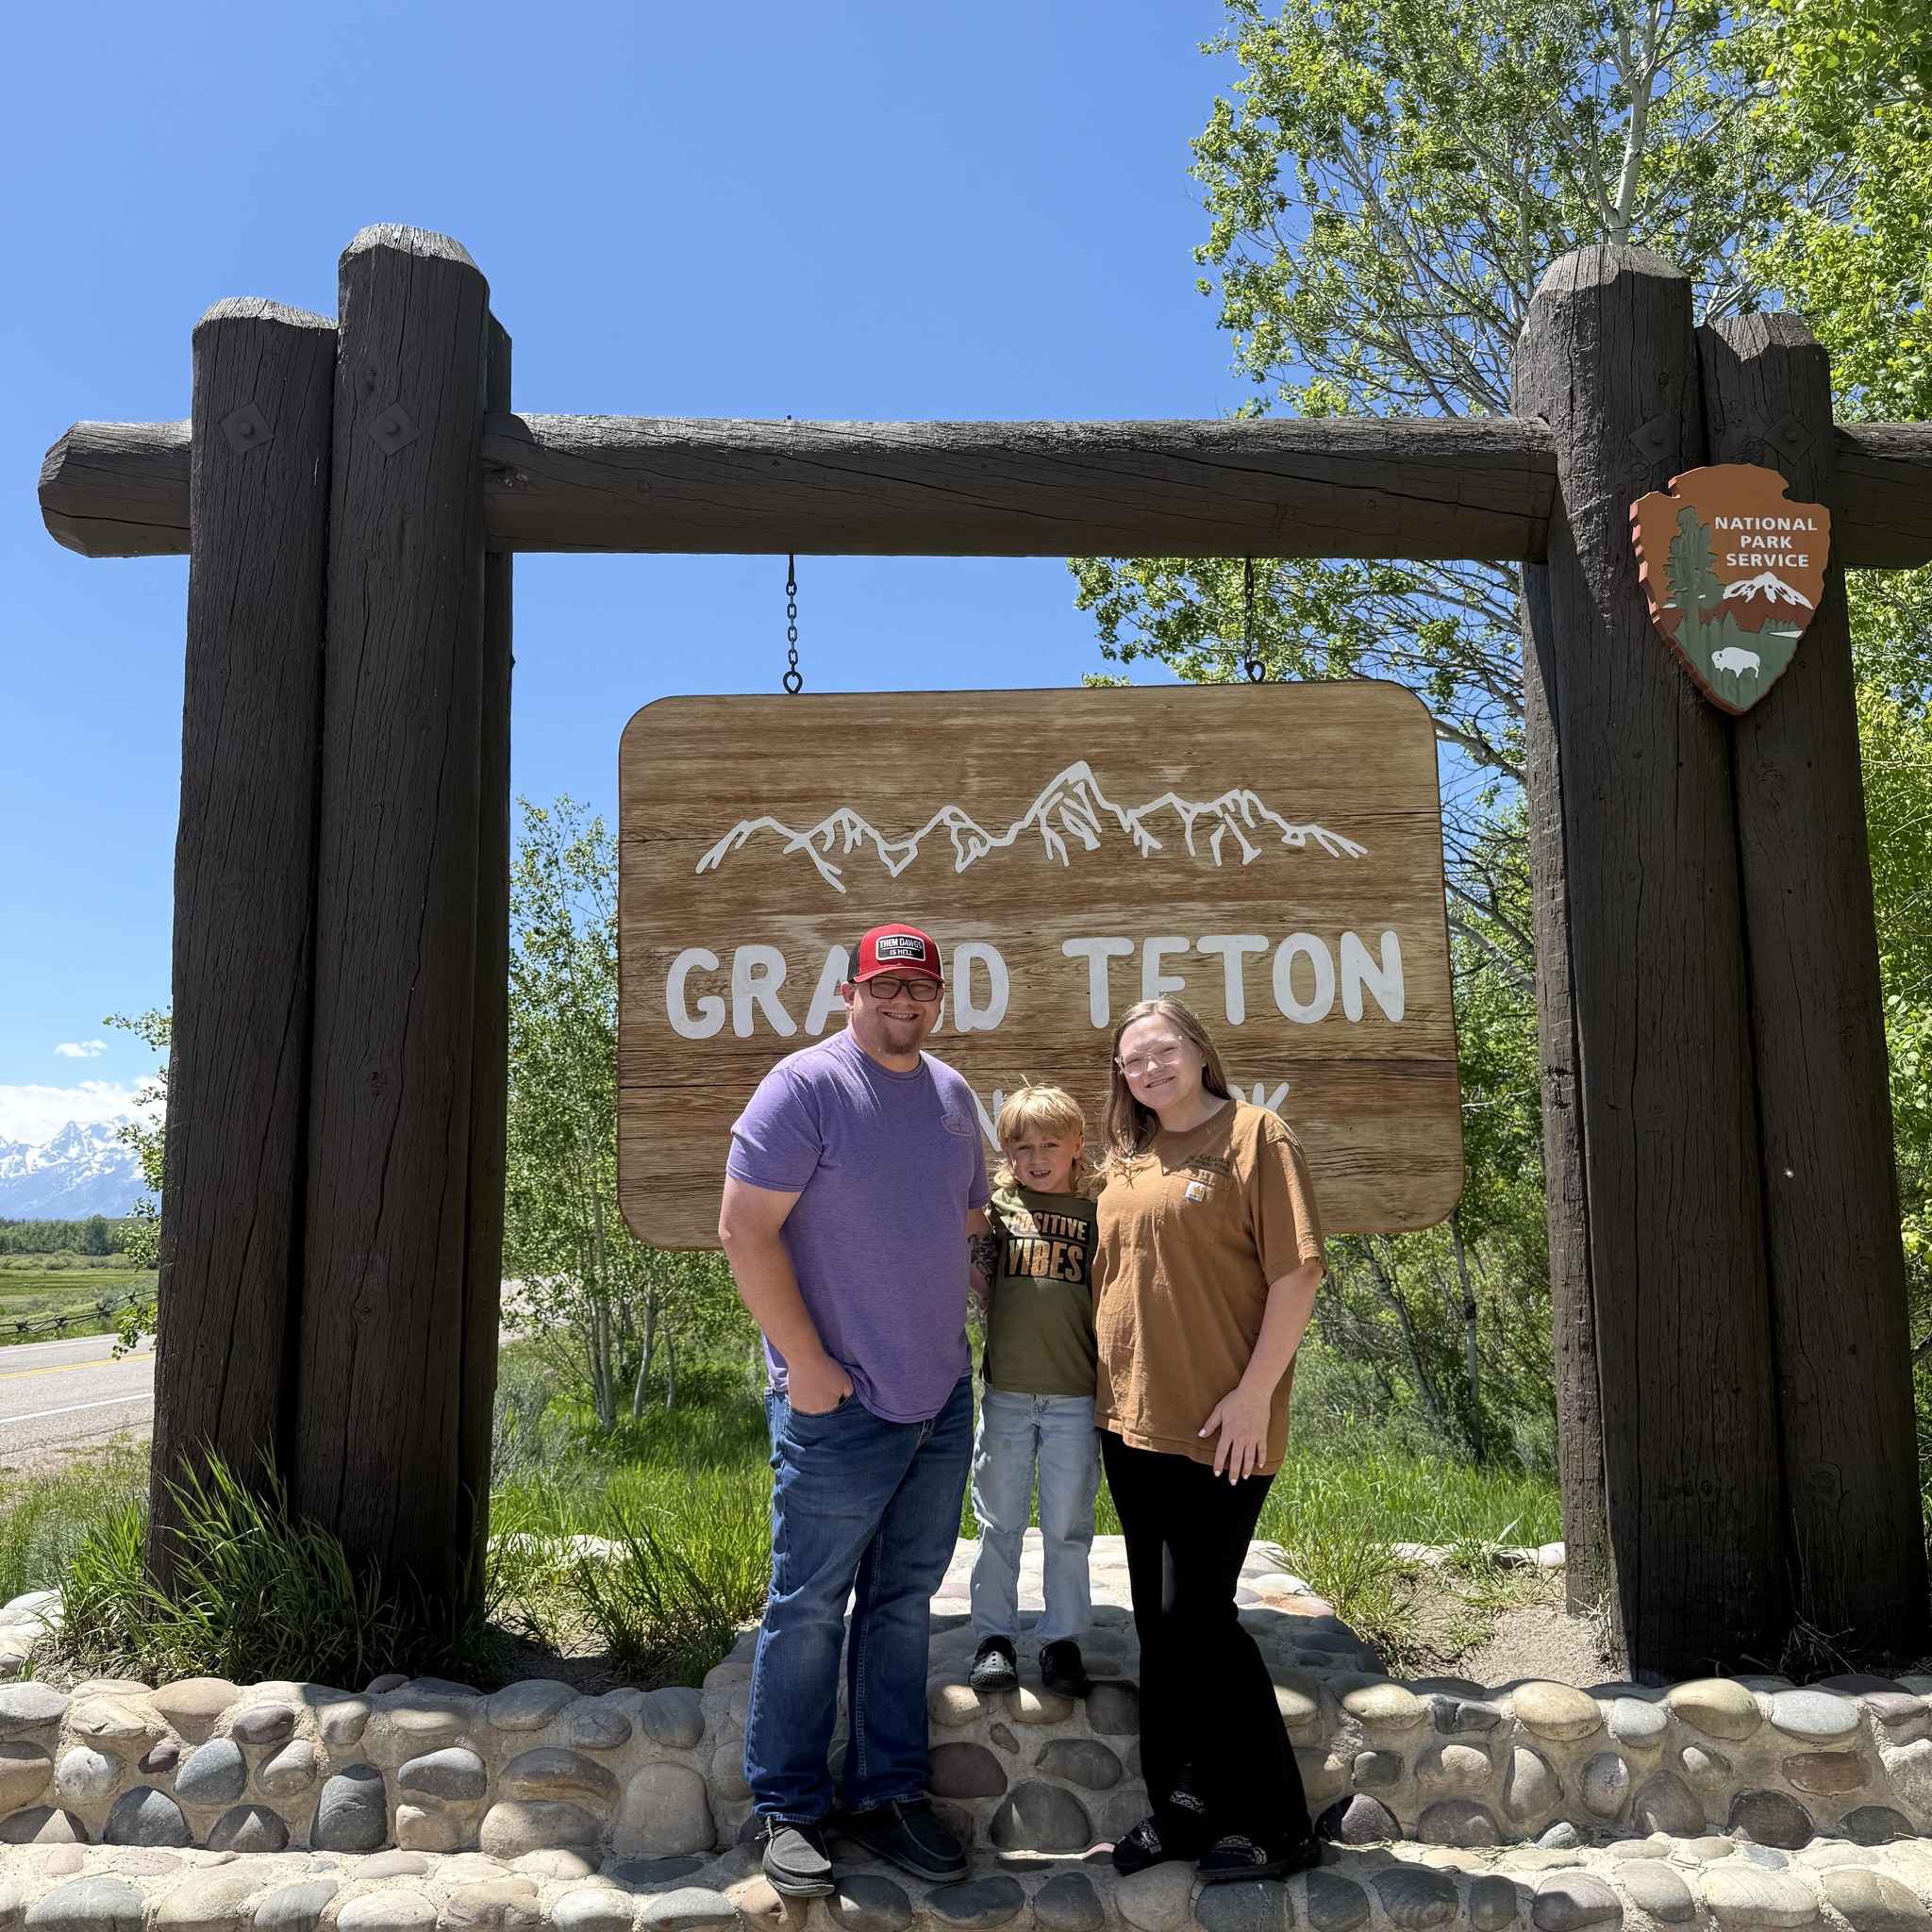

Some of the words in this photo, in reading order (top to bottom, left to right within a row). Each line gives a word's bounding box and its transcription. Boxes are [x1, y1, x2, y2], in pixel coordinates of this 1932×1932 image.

[1714, 516, 1818, 531] NATIONAL
[1740, 535, 1792, 549] PARK
[1725, 553, 1808, 567] SERVICE
[878, 939, 898, 949] THEM
[899, 938, 923, 950] DAWGS
[666, 942, 1009, 1040] GRAD
[1061, 930, 1405, 1029] TETON
[1008, 1239, 1084, 1282] VIBES
